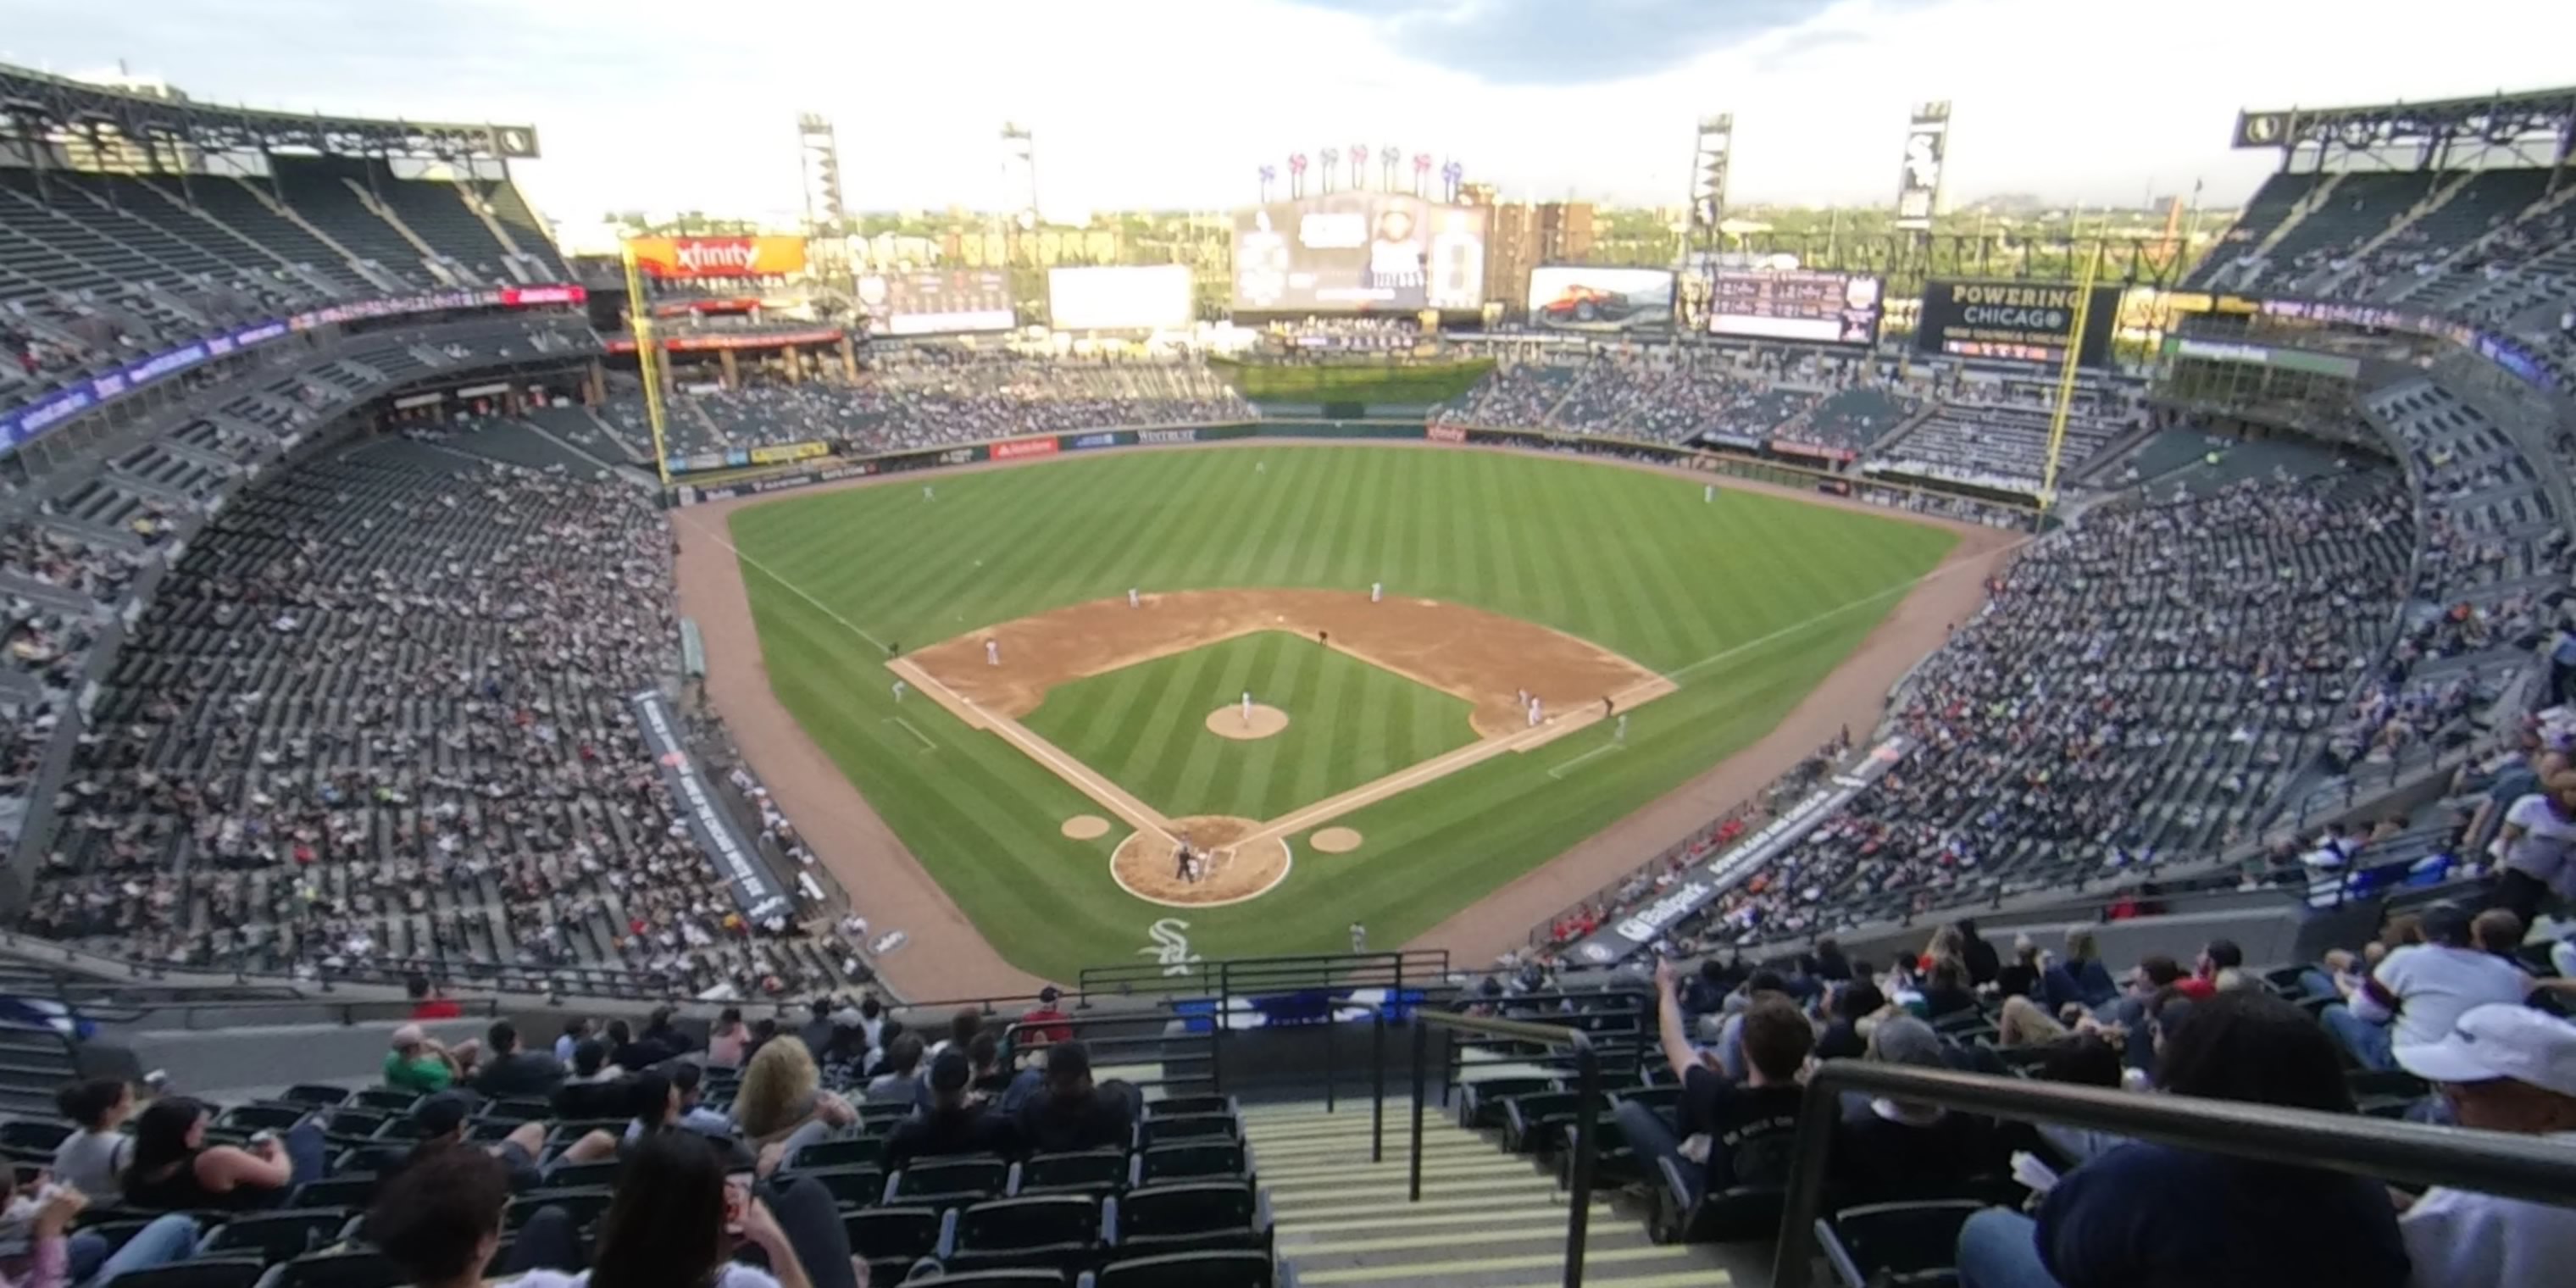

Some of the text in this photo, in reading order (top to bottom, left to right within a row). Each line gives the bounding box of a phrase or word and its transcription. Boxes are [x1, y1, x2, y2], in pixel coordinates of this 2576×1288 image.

[677, 241, 760, 271] xfinity
[1952, 285, 2082, 308] POWERING
[1963, 306, 2062, 329] CHICAGO
